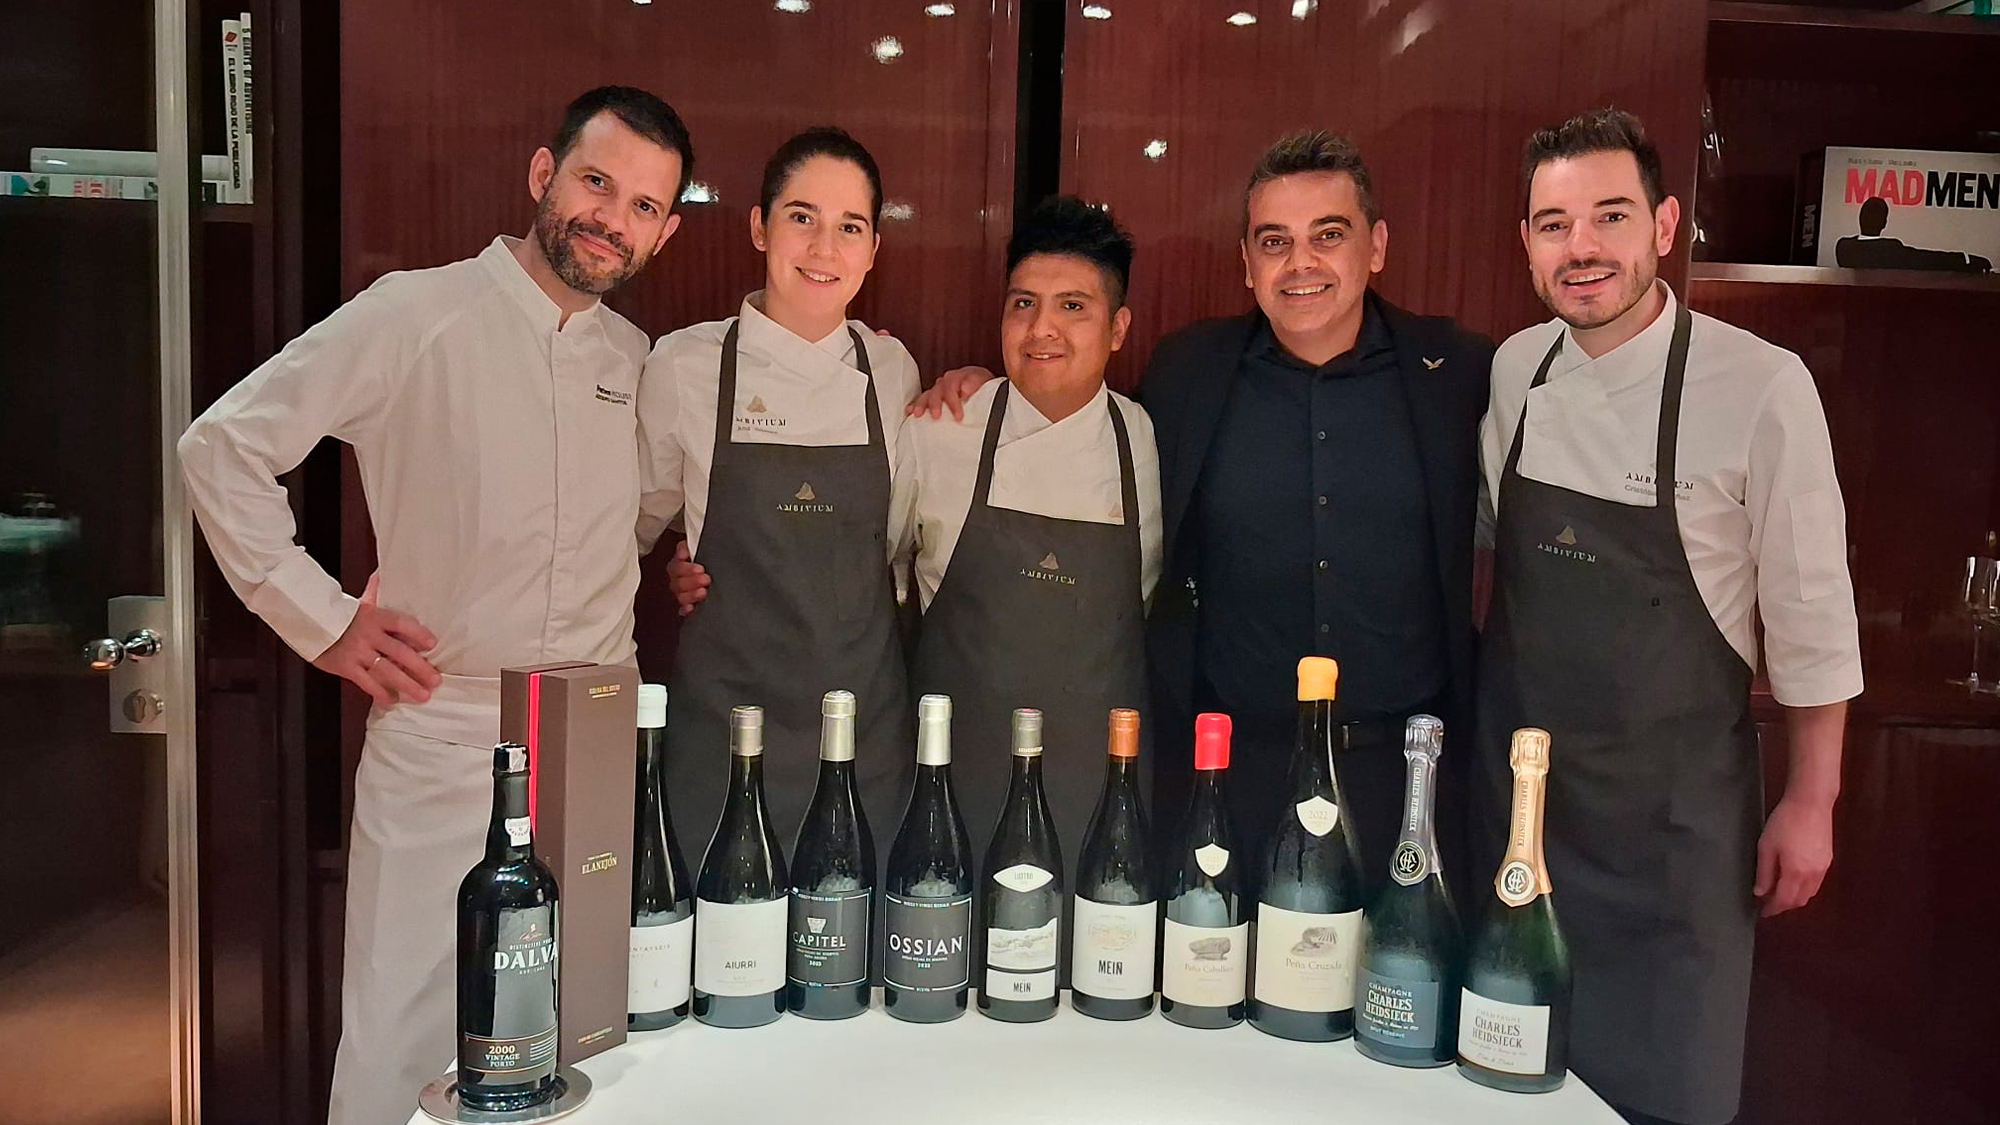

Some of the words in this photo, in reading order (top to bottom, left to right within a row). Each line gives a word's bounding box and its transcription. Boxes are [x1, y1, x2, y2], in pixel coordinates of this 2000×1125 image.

[228, 68, 237, 93] LIBRO
[229, 94, 238, 116] ROJO
[230, 117, 239, 129] DE
[231, 130, 239, 140] LA
[735, 416, 786, 426] MBIVIUM
[777, 503, 834, 513] AMBIVIUM
[1537, 542, 1597, 564] AMBIVIUM
[1020, 568, 1077, 585] AMBIVIUM
[1412, 767, 1422, 796] CHARLES
[792, 931, 847, 948] CAPITEL
[889, 934, 963, 957] OSSIAN
[724, 960, 757, 970] AIURRI
[1098, 960, 1123, 975] MEIN
[1013, 982, 1031, 993] MEIN
[1368, 982, 1413, 997] CHAMPAGNE
[1368, 989, 1413, 1011] CHARLES
[1365, 1001, 1415, 1023] HEIDSIECK
[1475, 1016, 1521, 1037] CHARLES
[1472, 1027, 1523, 1049] HEIDSIECK
[484, 1053, 520, 1061] VINTAGE
[488, 1045, 516, 1055] 2000
